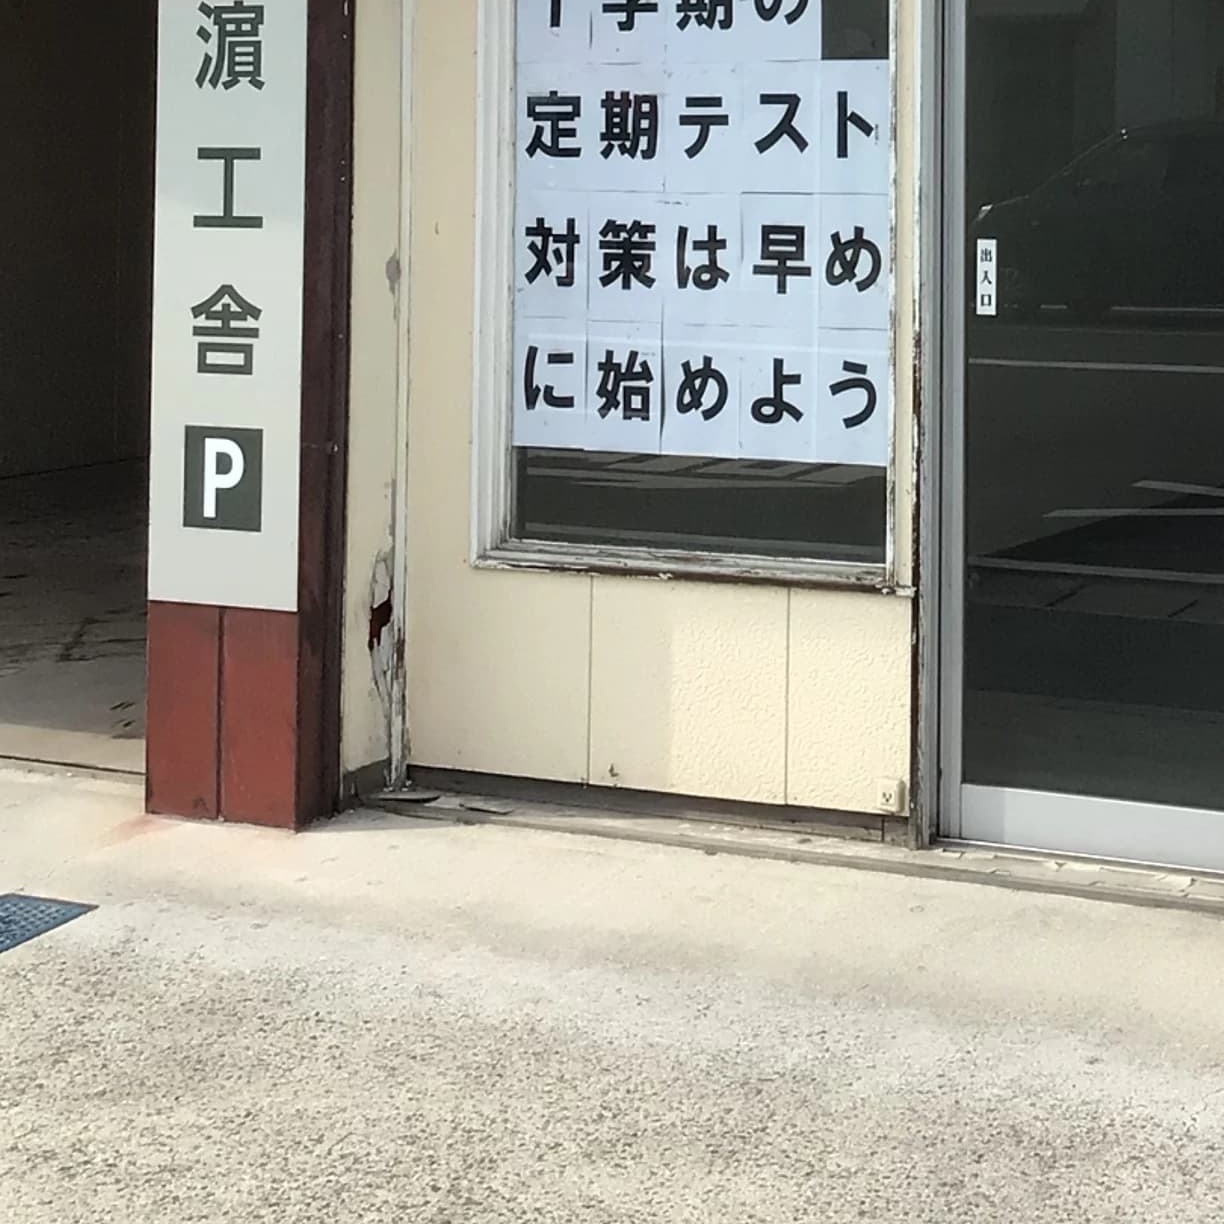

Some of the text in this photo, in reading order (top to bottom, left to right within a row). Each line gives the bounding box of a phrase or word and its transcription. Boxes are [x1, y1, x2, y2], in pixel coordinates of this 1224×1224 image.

[525, 91, 874, 160] 定期テスト
[524, 217, 882, 294] 対策は早め
[980, 247, 993, 307] 出入口
[524, 345, 878, 429] に始めよう
[202, 437, 245, 519] P
